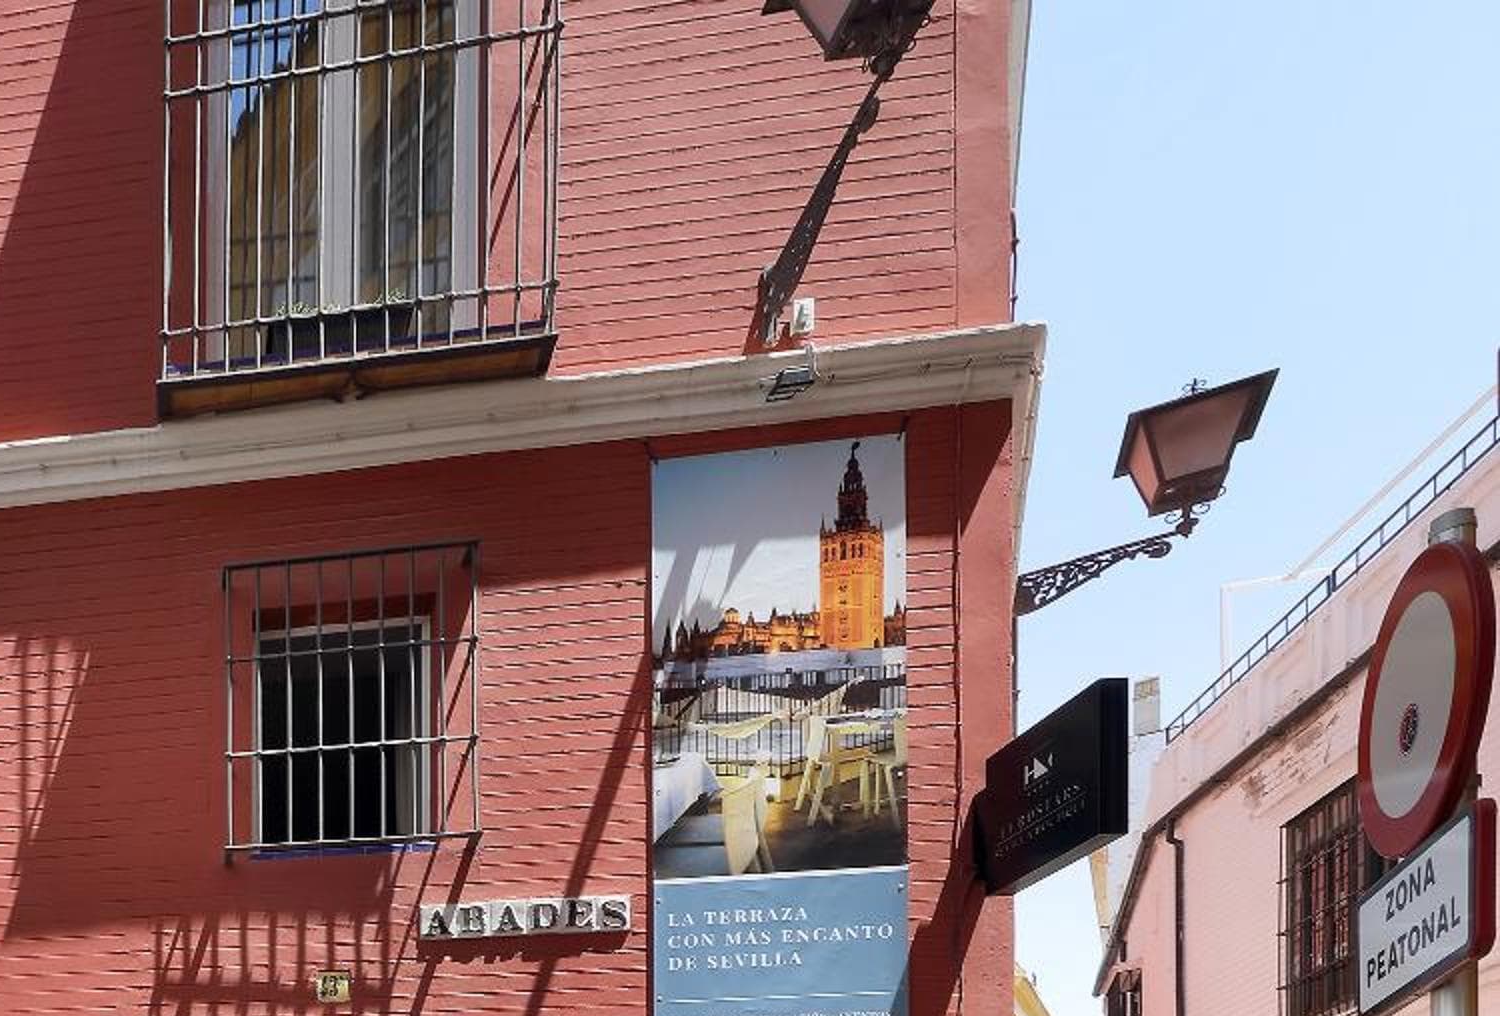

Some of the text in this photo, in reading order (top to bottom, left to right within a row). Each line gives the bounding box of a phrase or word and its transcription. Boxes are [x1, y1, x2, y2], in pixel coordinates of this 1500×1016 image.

[1385, 858, 1436, 922] ZONA
[421, 899, 628, 937] ABADES
[668, 906, 808, 927] LA TERRAZA
[667, 923, 894, 949] CON MÁS ENCANTO
[1367, 895, 1461, 988] PEATONAL
[668, 951, 803, 971] DE SEVILLA
